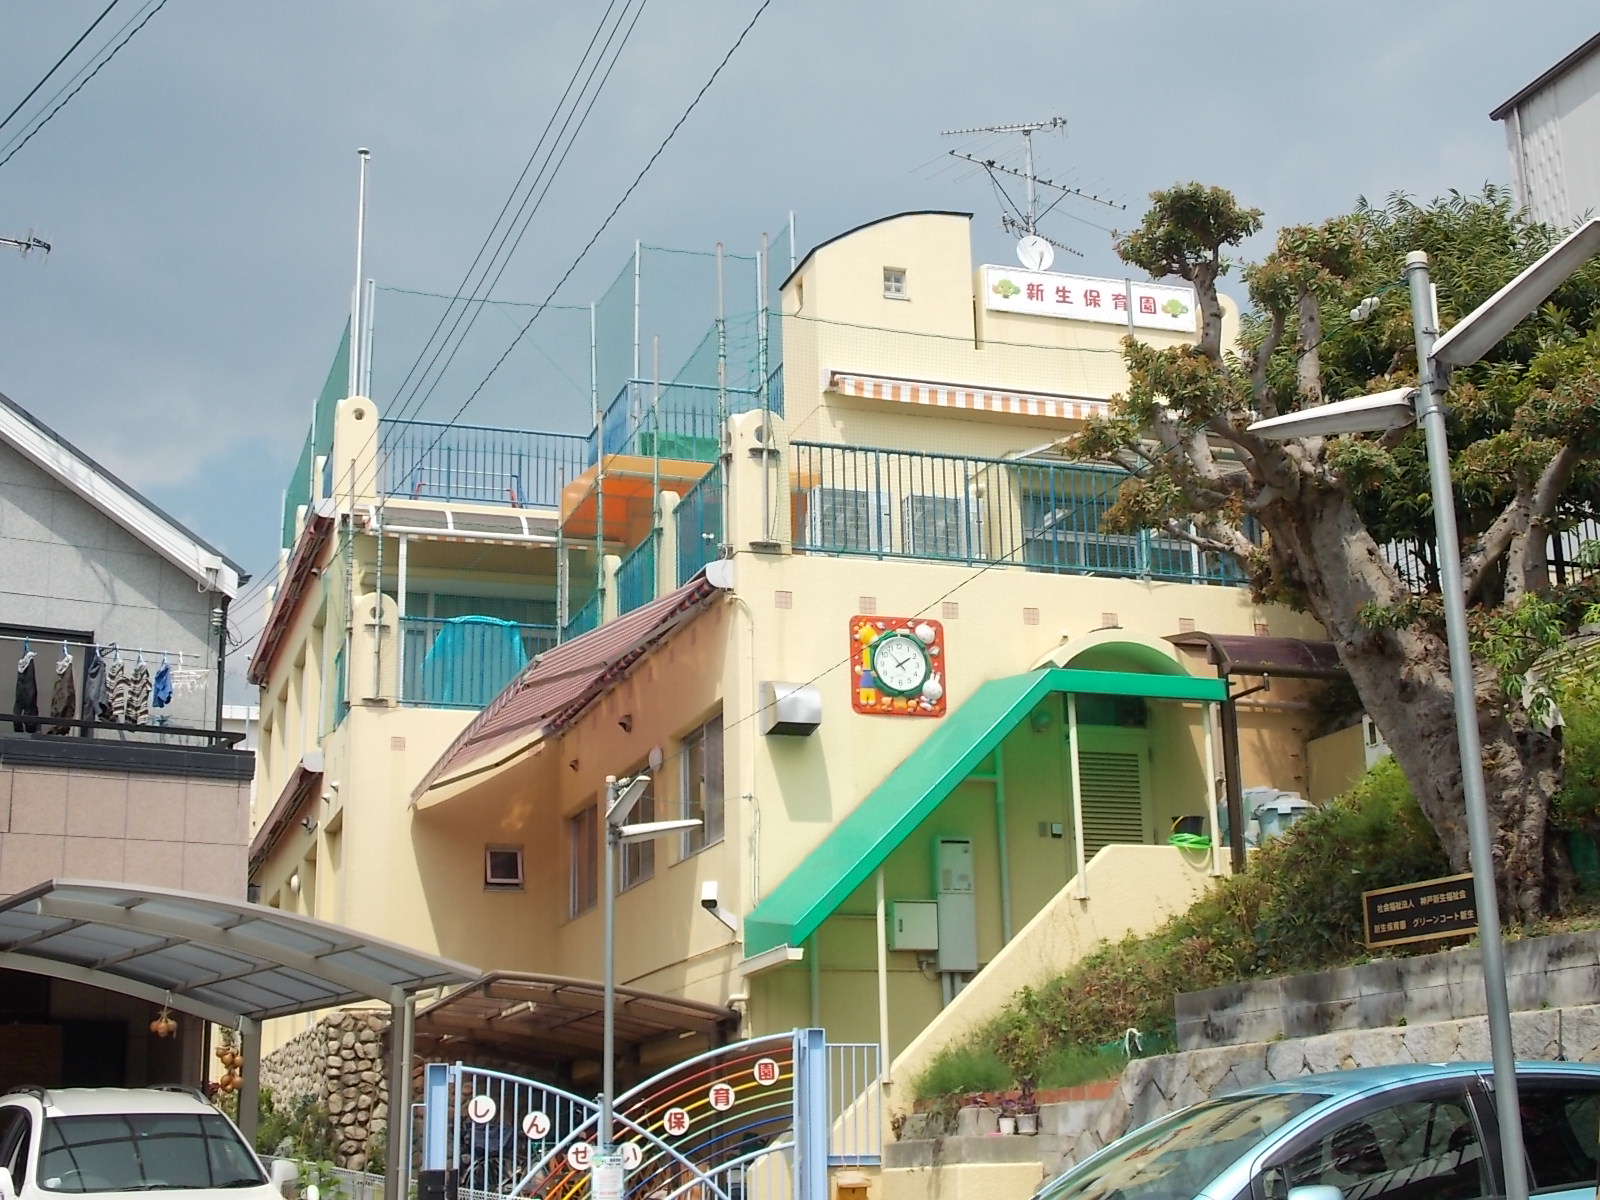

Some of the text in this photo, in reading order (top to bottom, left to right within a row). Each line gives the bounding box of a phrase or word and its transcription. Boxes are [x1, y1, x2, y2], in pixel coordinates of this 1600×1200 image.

[1026, 282, 1157, 315] 新生保育園
